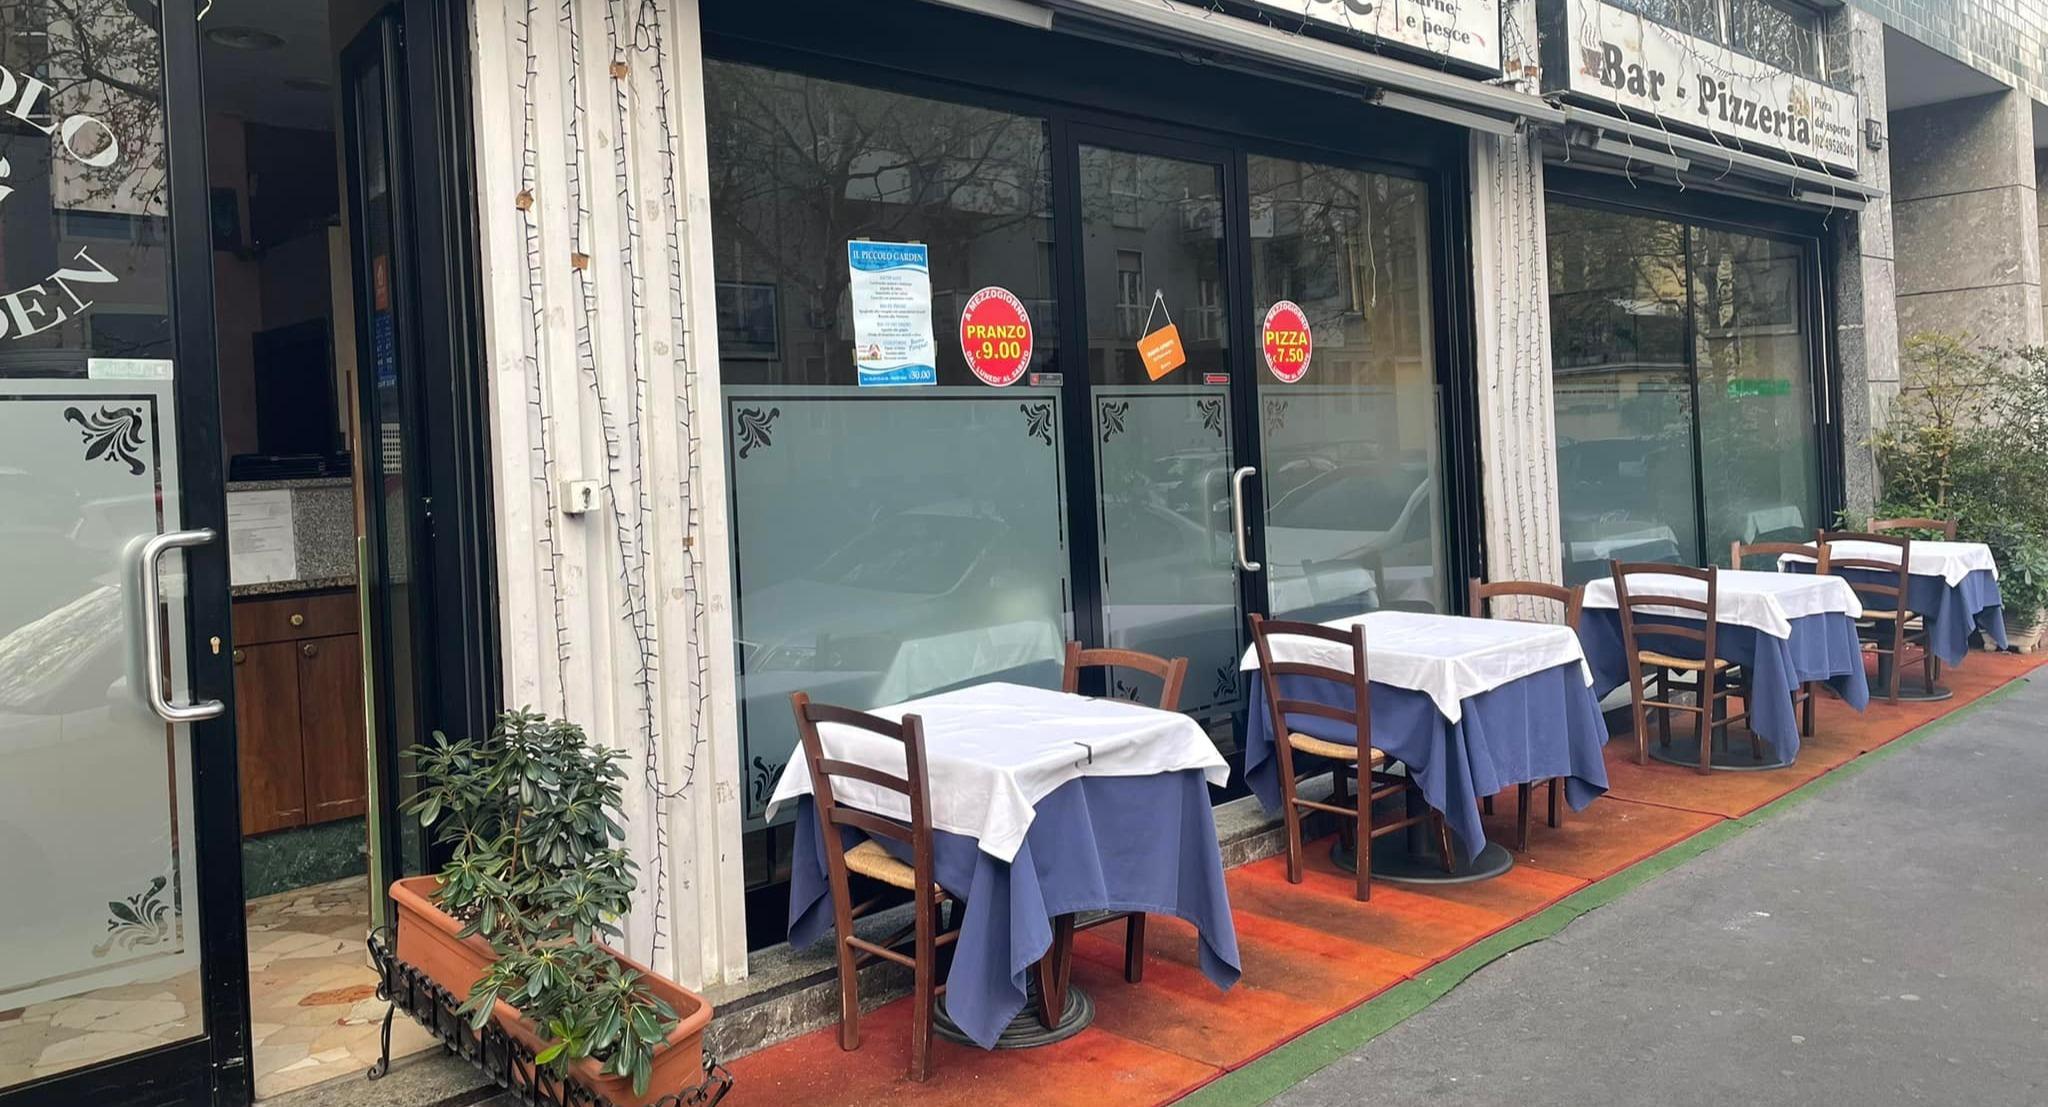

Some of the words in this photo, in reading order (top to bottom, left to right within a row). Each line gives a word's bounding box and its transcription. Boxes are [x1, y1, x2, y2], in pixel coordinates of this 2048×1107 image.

[1406, 16, 1416, 28] e
[1423, 19, 1470, 44] pesce
[1600, 41, 1665, 100] Bar
[1697, 73, 1810, 144] Pizzeria
[862, 250, 892, 261] PICCOLO
[893, 252, 924, 264] GARDEN
[965, 313, 972, 322] A
[969, 290, 1027, 322] MEZZOGIORNO
[967, 325, 1026, 339] PRANZO
[1266, 331, 1308, 345] PIZZA
